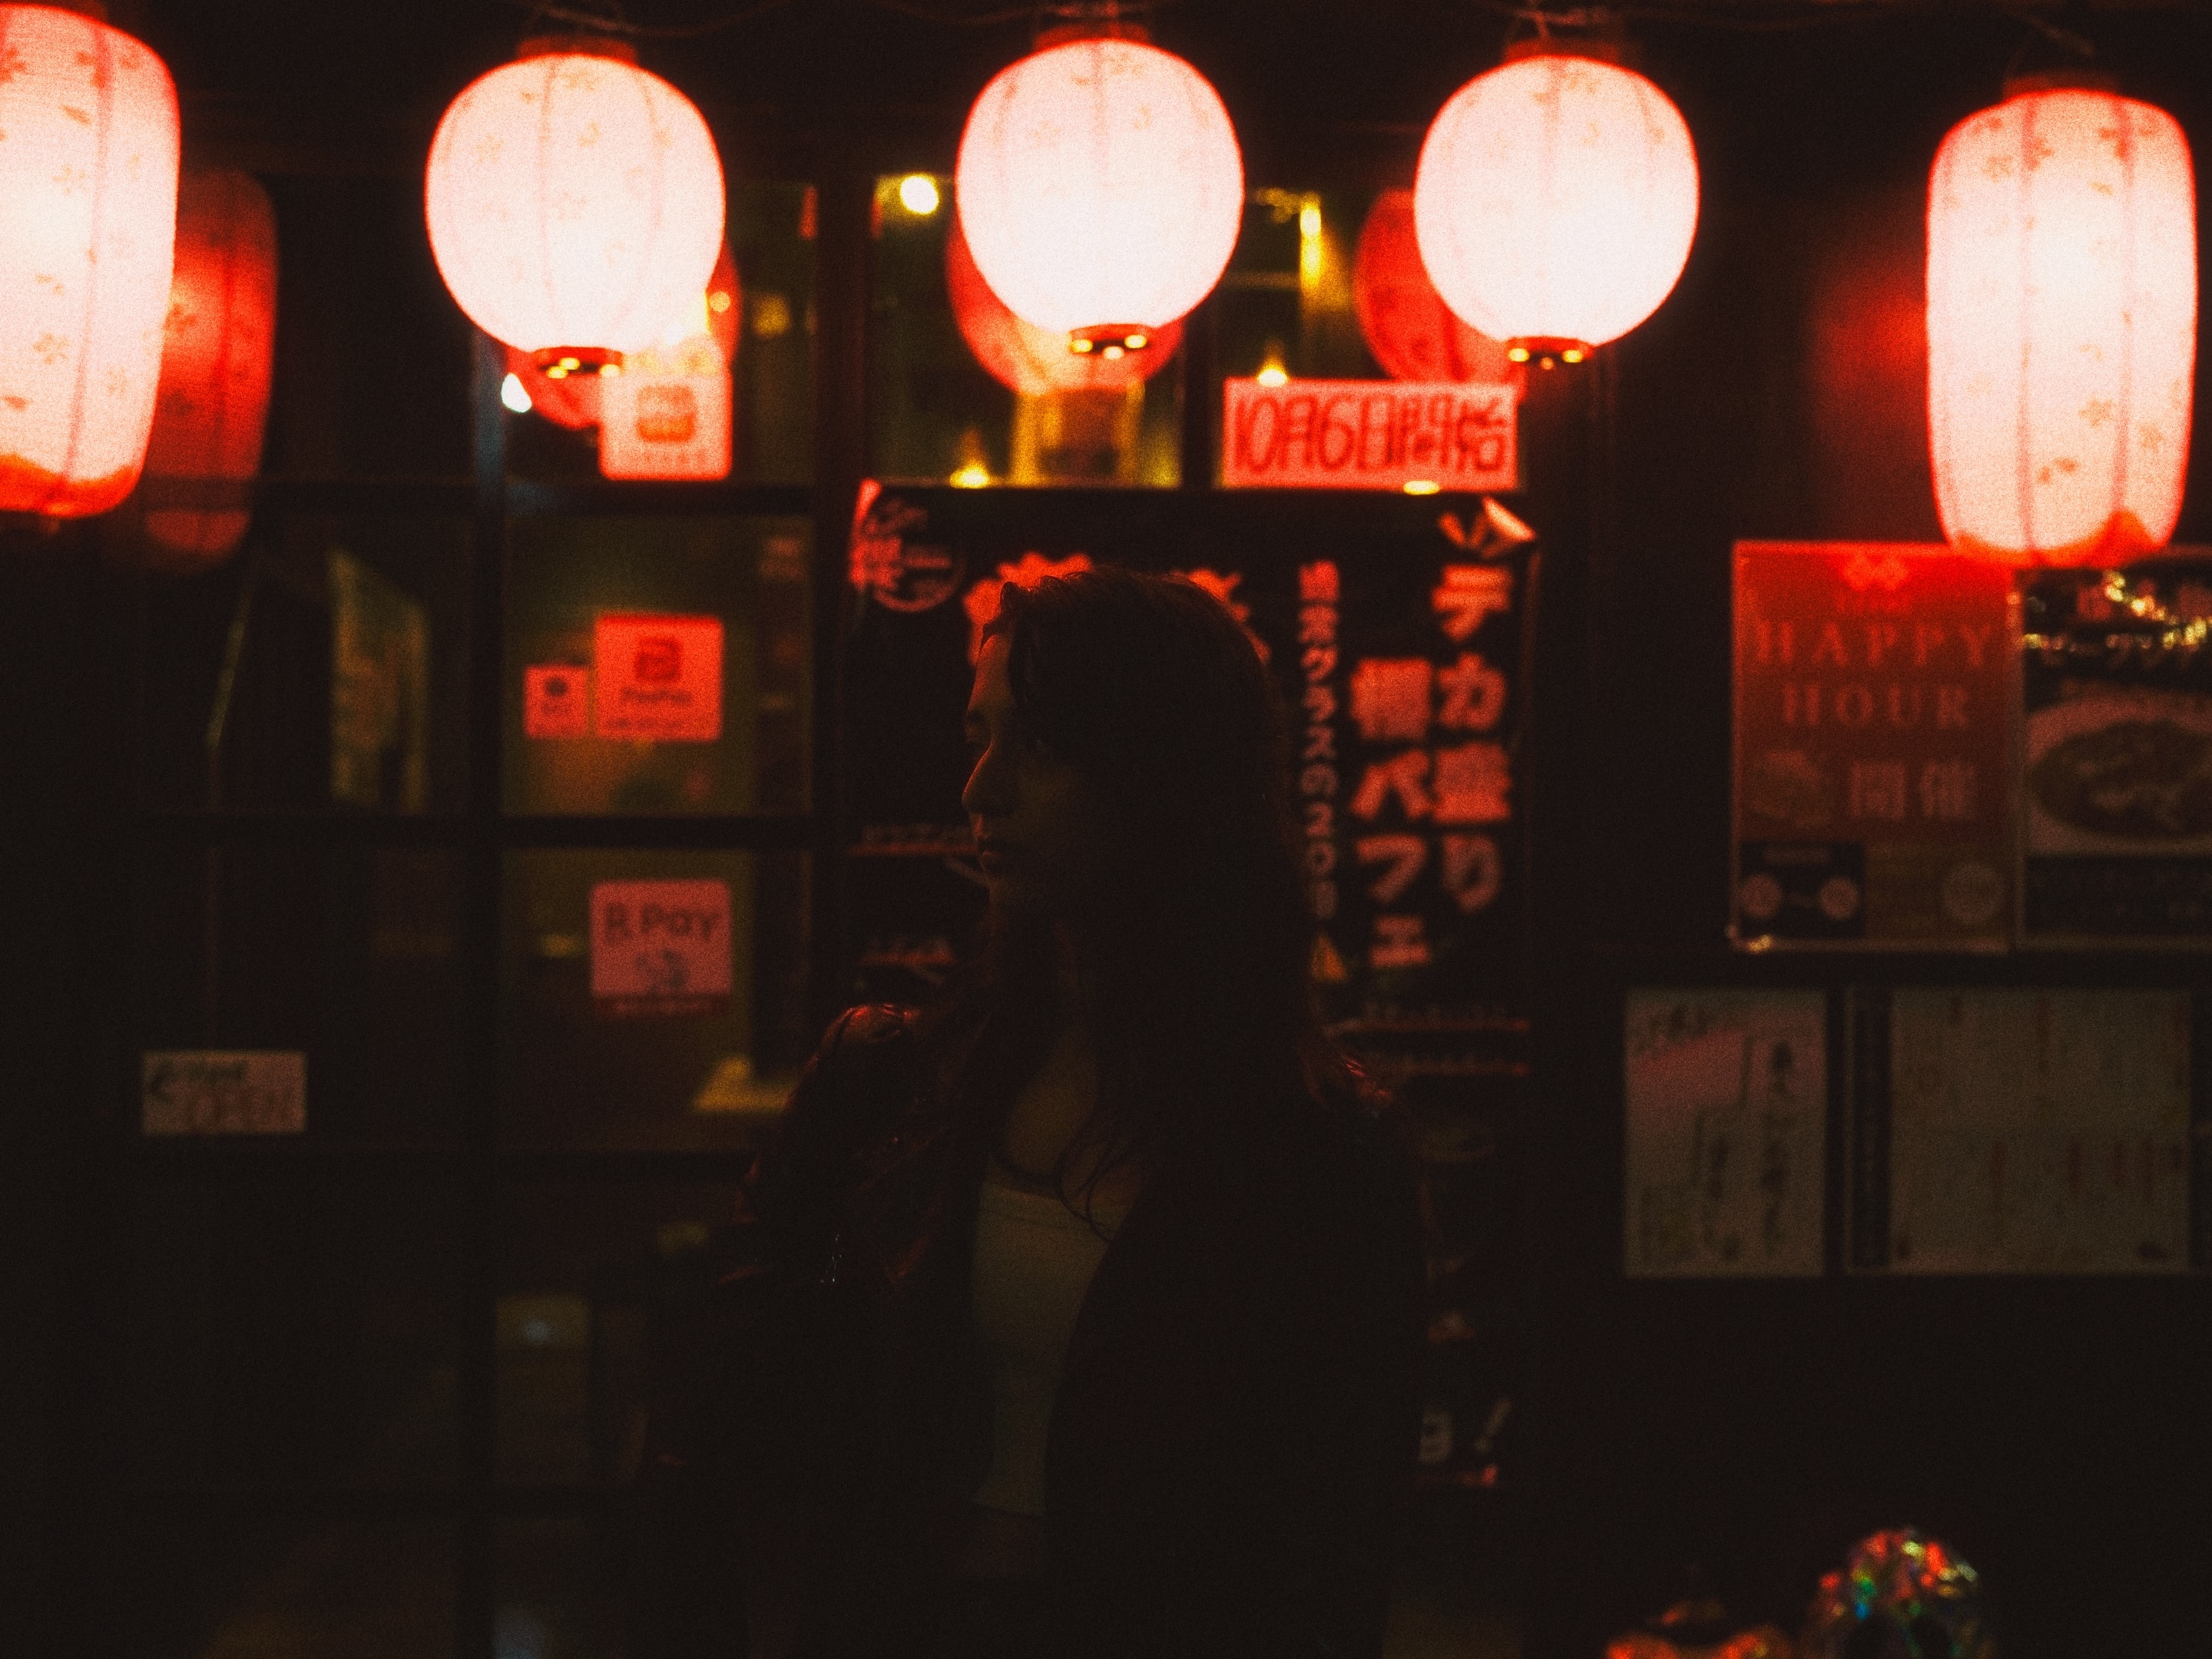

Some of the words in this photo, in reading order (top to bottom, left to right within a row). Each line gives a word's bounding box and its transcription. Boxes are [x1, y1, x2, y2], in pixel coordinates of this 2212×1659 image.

[1755, 620, 1993, 669] HAPPY
[1782, 683, 1971, 728] HOUR
[641, 902, 722, 942] Pay
